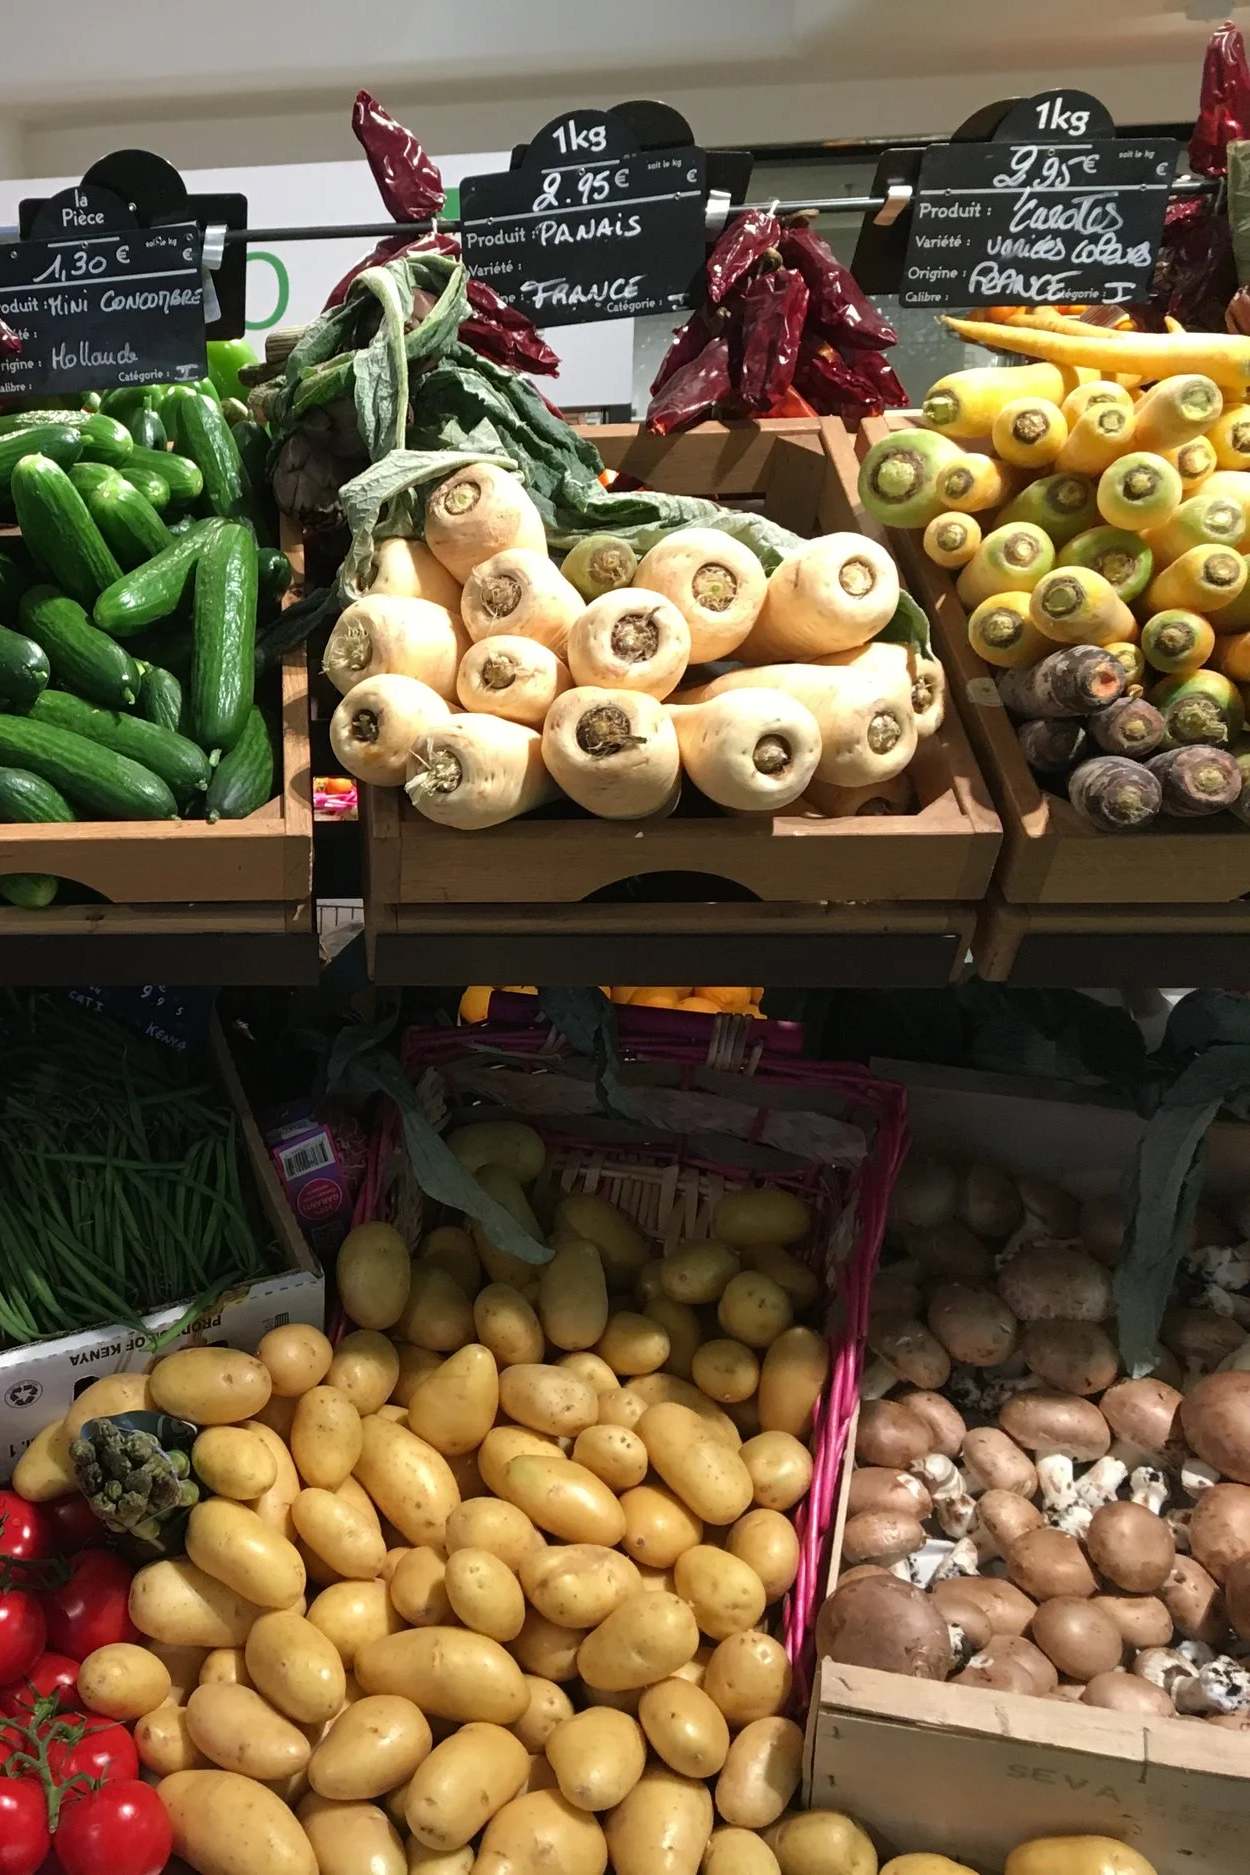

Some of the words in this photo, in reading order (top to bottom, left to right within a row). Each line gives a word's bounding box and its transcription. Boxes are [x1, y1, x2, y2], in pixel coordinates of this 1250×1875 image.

[1035, 97, 1090, 137] 1kg
[552, 119, 607, 154] 1kg
[671, 158, 682, 168] kg
[75, 189, 88, 209] la
[62, 208, 104, 228] Pièce
[919, 203, 982, 219] Produit
[466, 229, 526, 248] Produit
[915, 235, 963, 249] Variété
[468, 262, 514, 277] Variété
[908, 266, 958, 282] Origine
[520, 274, 649, 310] FRANCE
[905, 292, 943, 302] Calibre
[1061, 287, 1100, 301] tégorie
[606, 298, 657, 314] Catégorie
[118, 369, 165, 383] Catégorie
[125, 1337, 147, 1353] OF
[69, 1342, 124, 1367] KENYA
